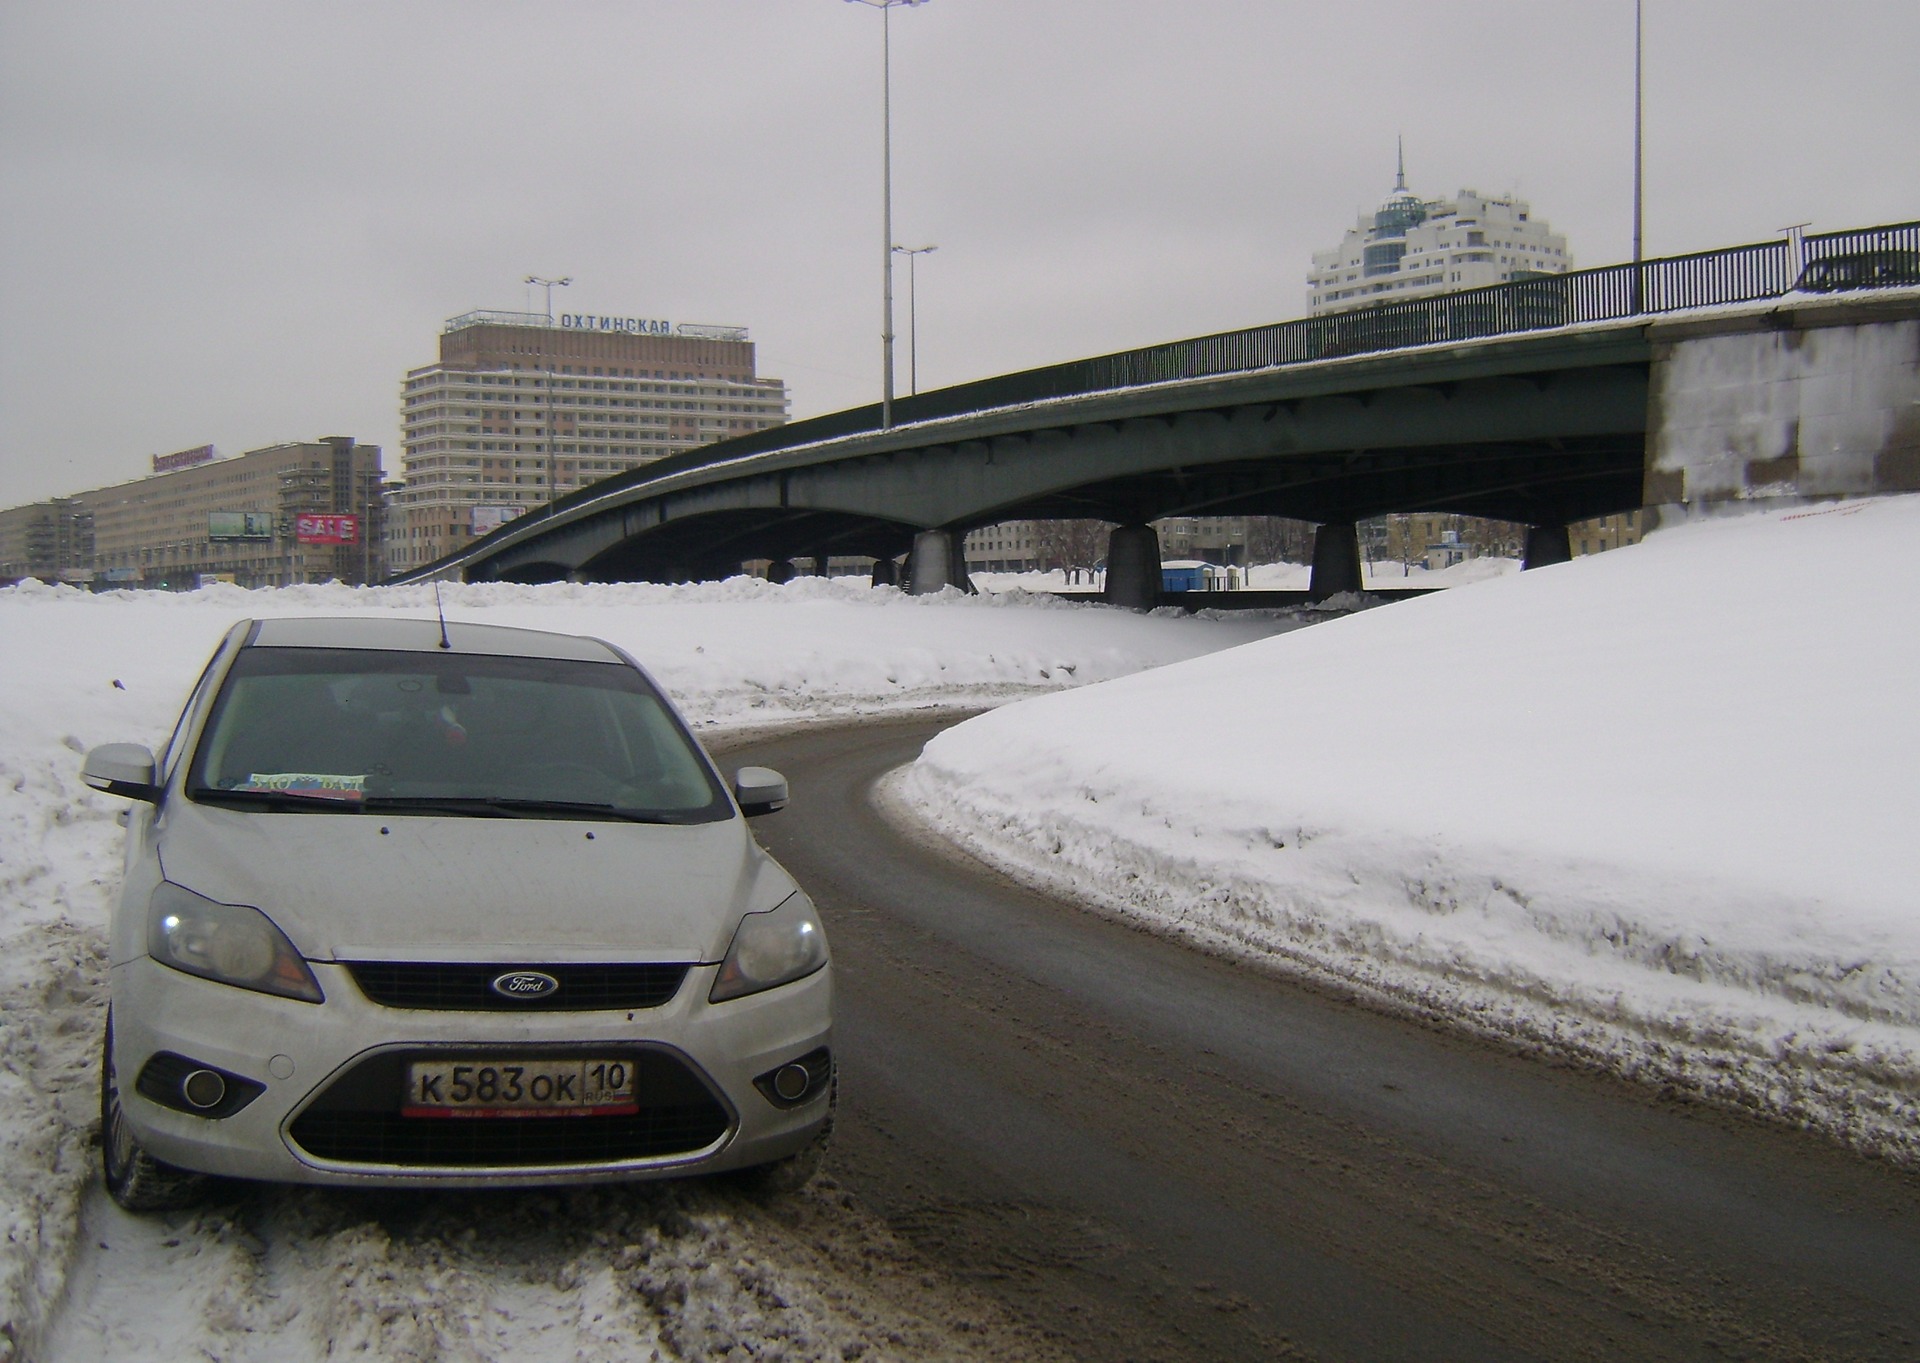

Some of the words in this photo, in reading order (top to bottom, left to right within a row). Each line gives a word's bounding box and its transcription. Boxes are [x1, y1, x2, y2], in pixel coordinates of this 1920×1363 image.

[562, 314, 670, 334] ОХТИНСКАЯ
[299, 519, 354, 538] SALE
[509, 976, 544, 991] Ford
[591, 1063, 625, 1090] 10
[585, 1091, 612, 1102] RUS
